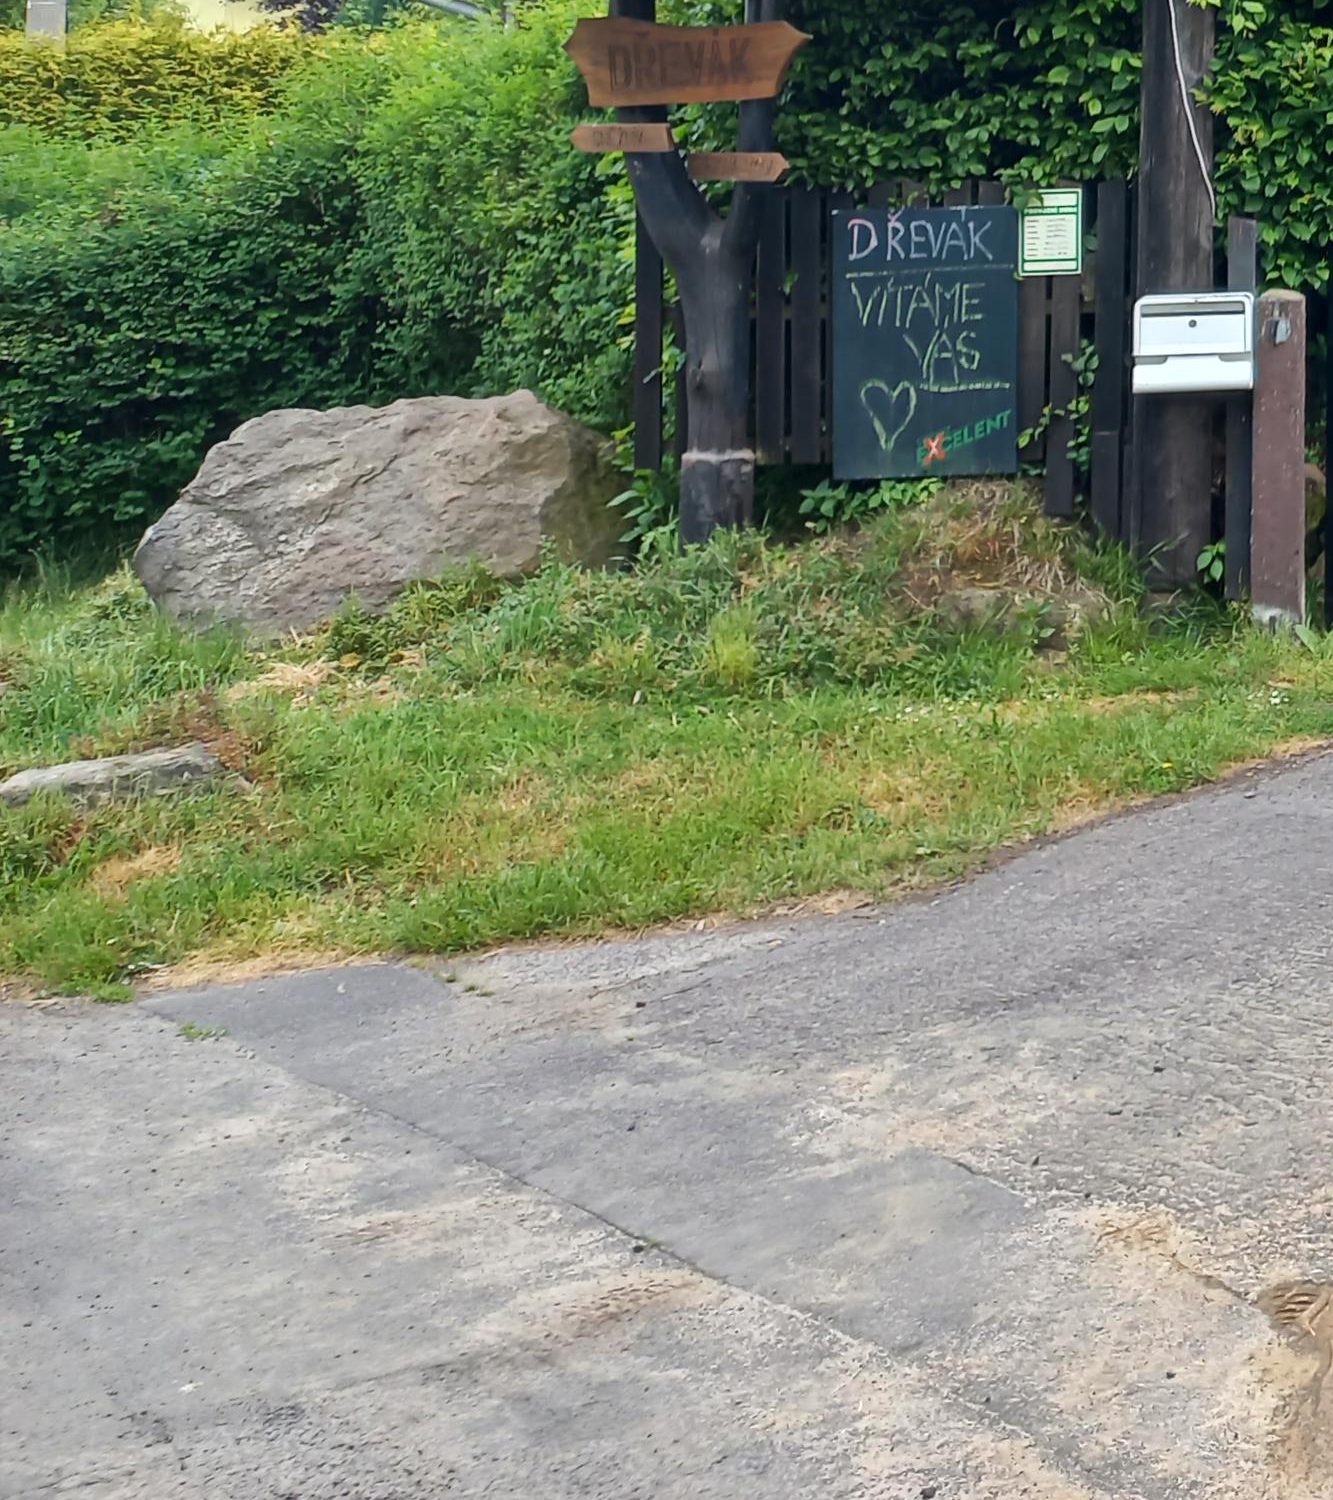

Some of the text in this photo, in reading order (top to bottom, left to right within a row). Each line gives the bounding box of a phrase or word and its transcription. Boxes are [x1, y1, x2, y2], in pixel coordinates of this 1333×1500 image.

[848, 206, 993, 261] DŘEVÁK
[851, 271, 986, 328] VÍTÁME
[903, 315, 980, 384] VÁS
[916, 408, 1012, 467] EXCELENT
